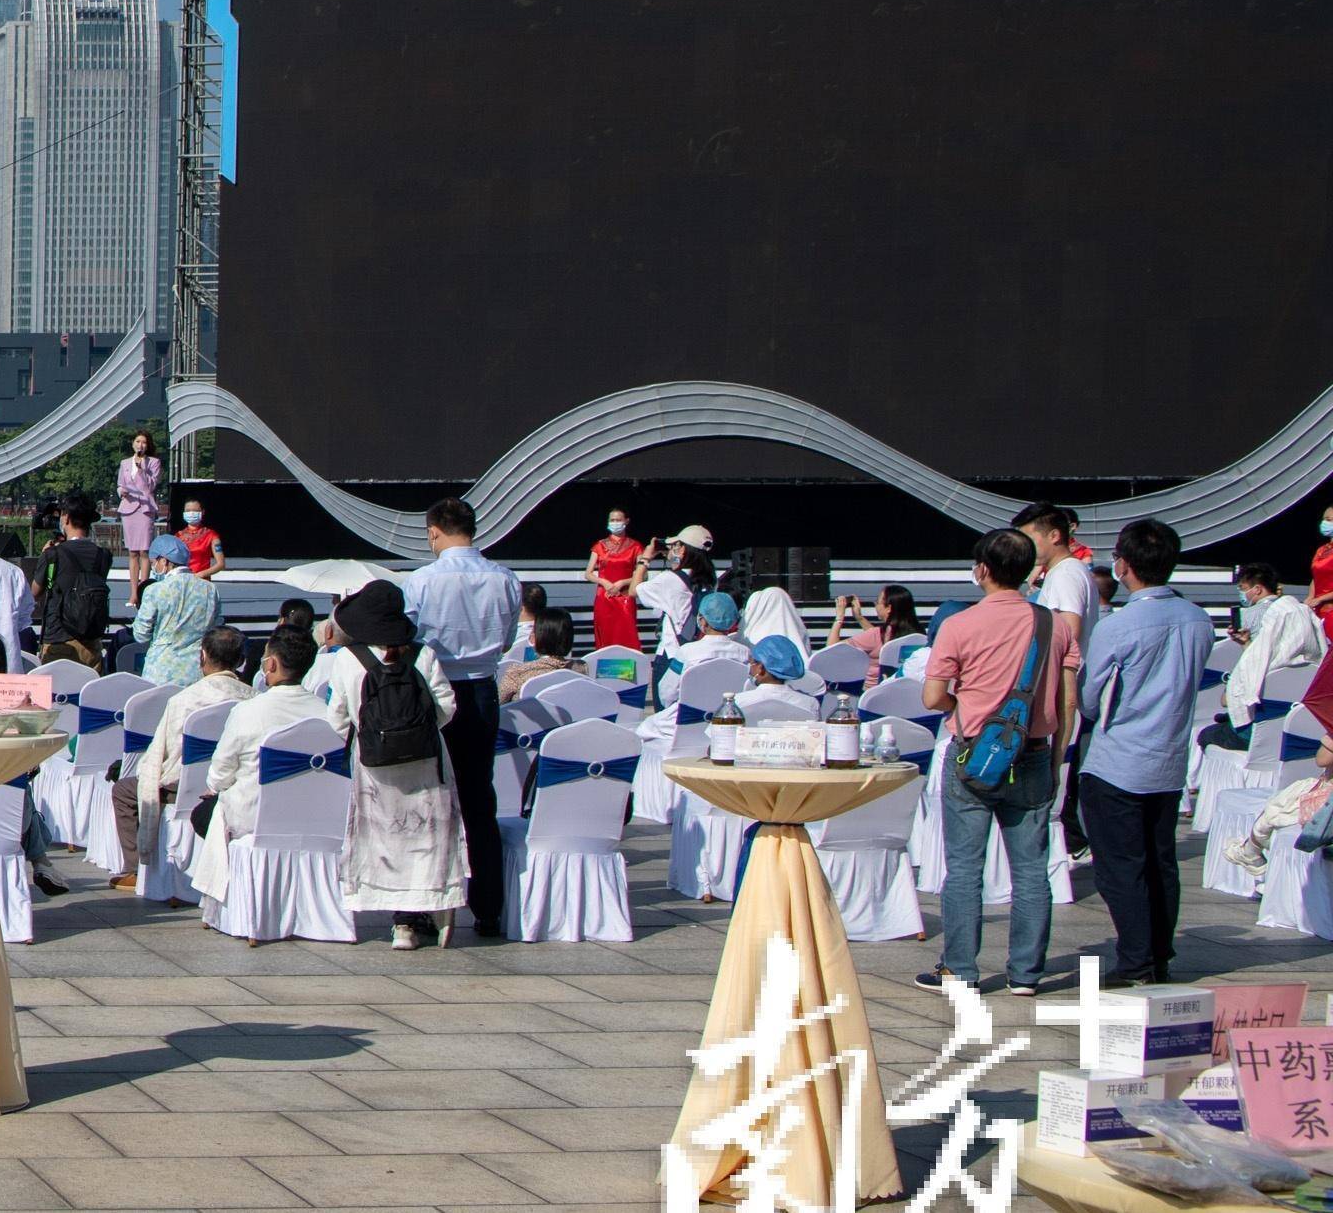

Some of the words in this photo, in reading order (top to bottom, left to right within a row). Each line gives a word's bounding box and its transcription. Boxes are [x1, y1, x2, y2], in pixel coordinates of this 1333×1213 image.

[1163, 999, 1201, 1016] 开郁颗粒
[1106, 1082, 1149, 1098] 开郁颗粒
[1287, 1099, 1333, 1140] 系
